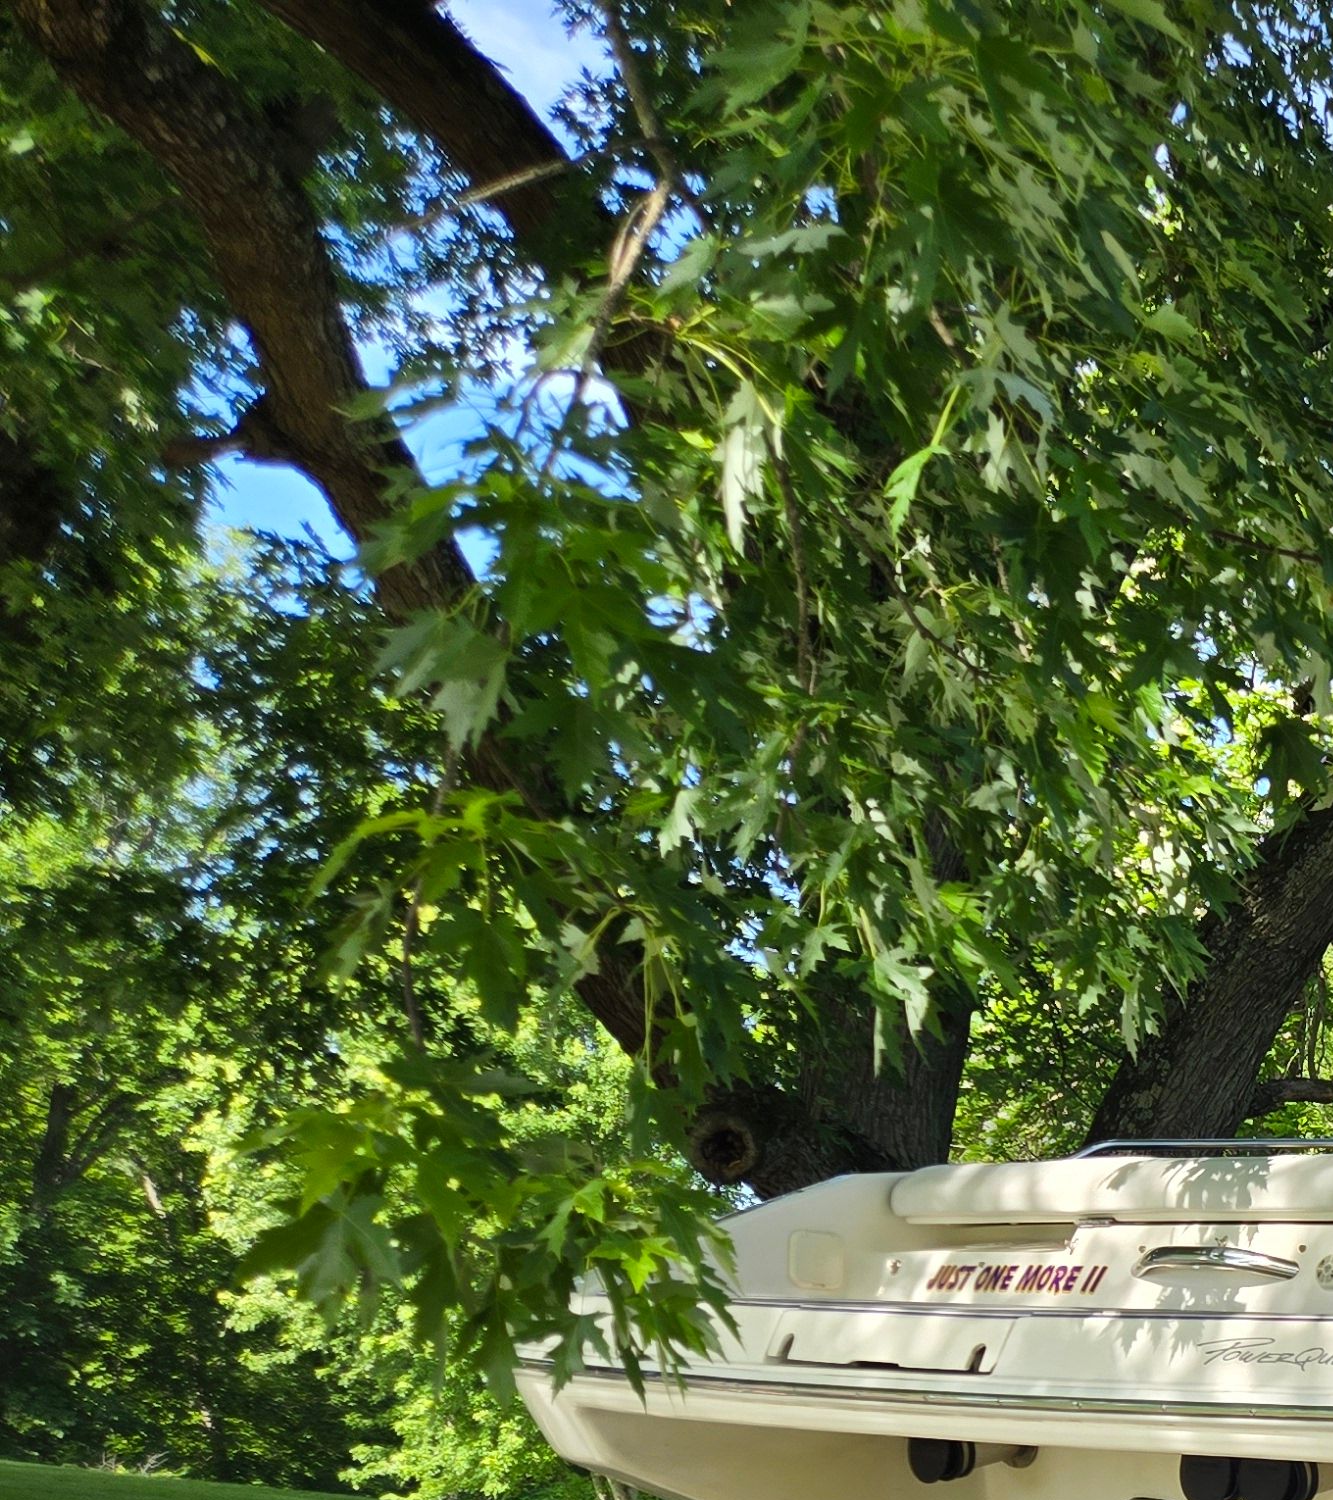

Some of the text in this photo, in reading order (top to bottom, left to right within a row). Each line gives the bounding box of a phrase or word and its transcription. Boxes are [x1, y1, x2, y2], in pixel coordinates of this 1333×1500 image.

[926, 1264, 1109, 1294] JUST ONE MORE II
